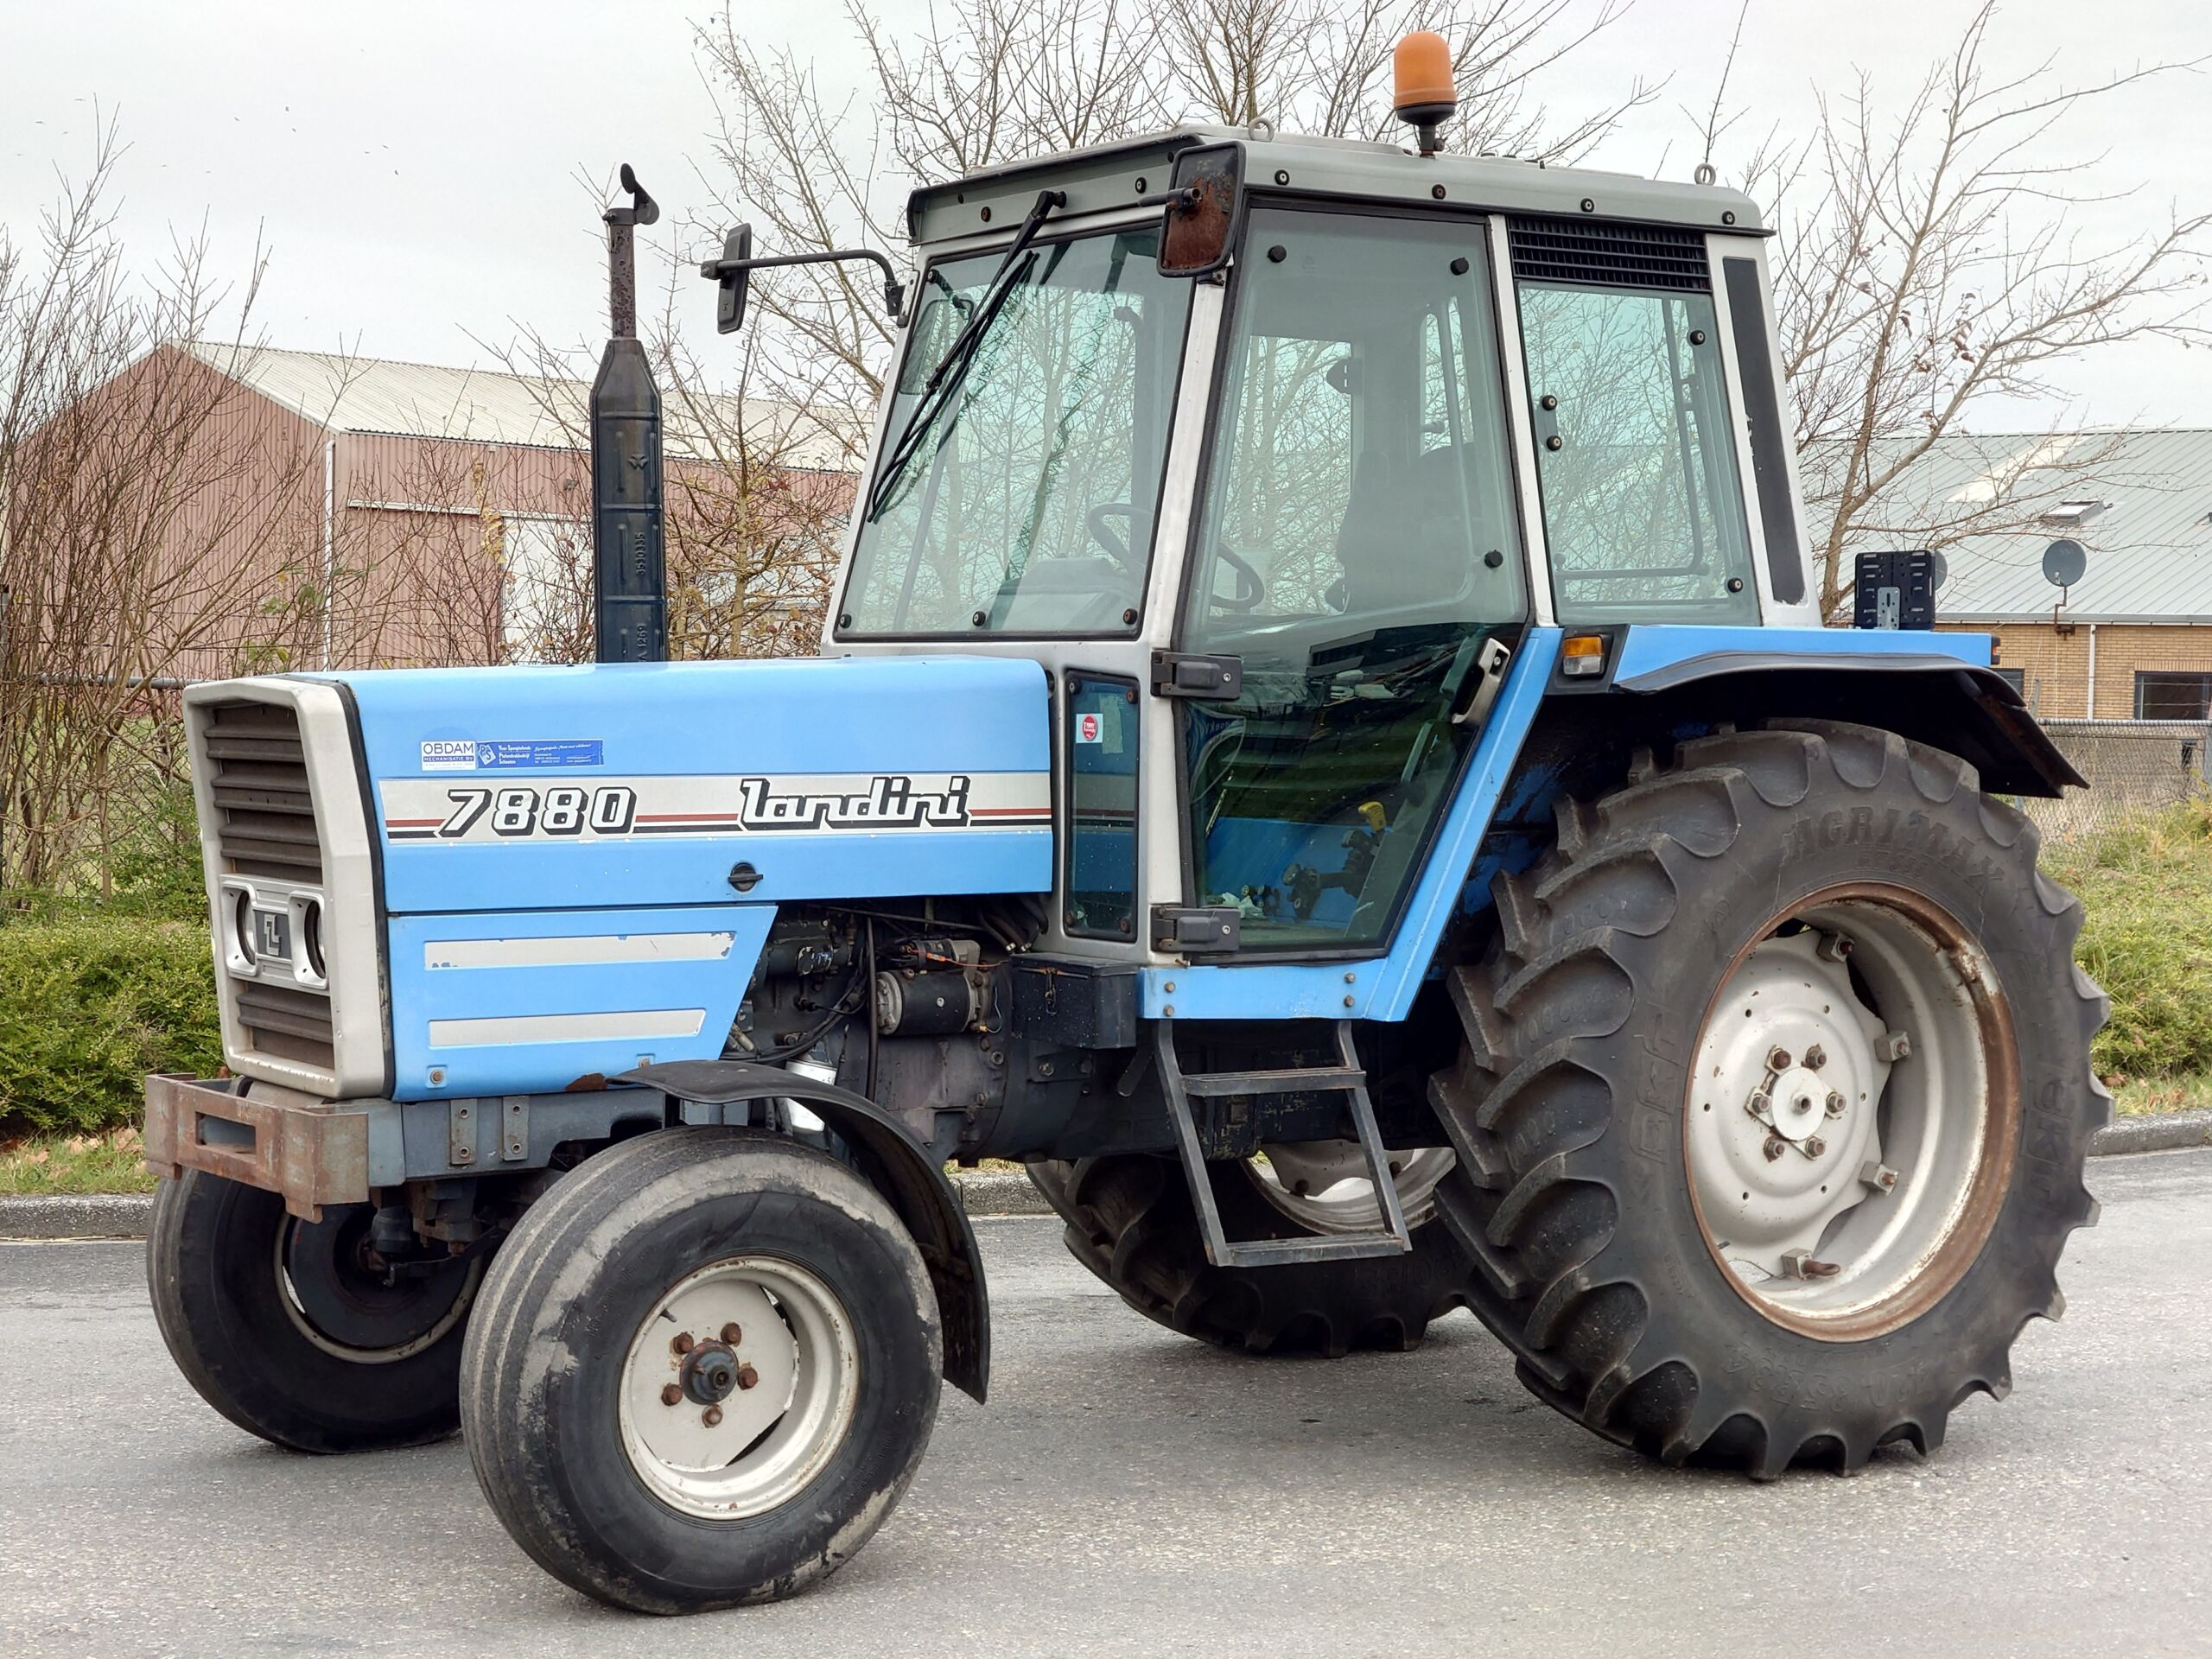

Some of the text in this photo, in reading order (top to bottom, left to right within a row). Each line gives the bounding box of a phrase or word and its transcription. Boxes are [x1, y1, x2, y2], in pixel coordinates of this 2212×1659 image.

[423, 742, 474, 754] OBDAM
[435, 787, 637, 839] 7880
[1785, 805, 2005, 897] AGRIMAX
